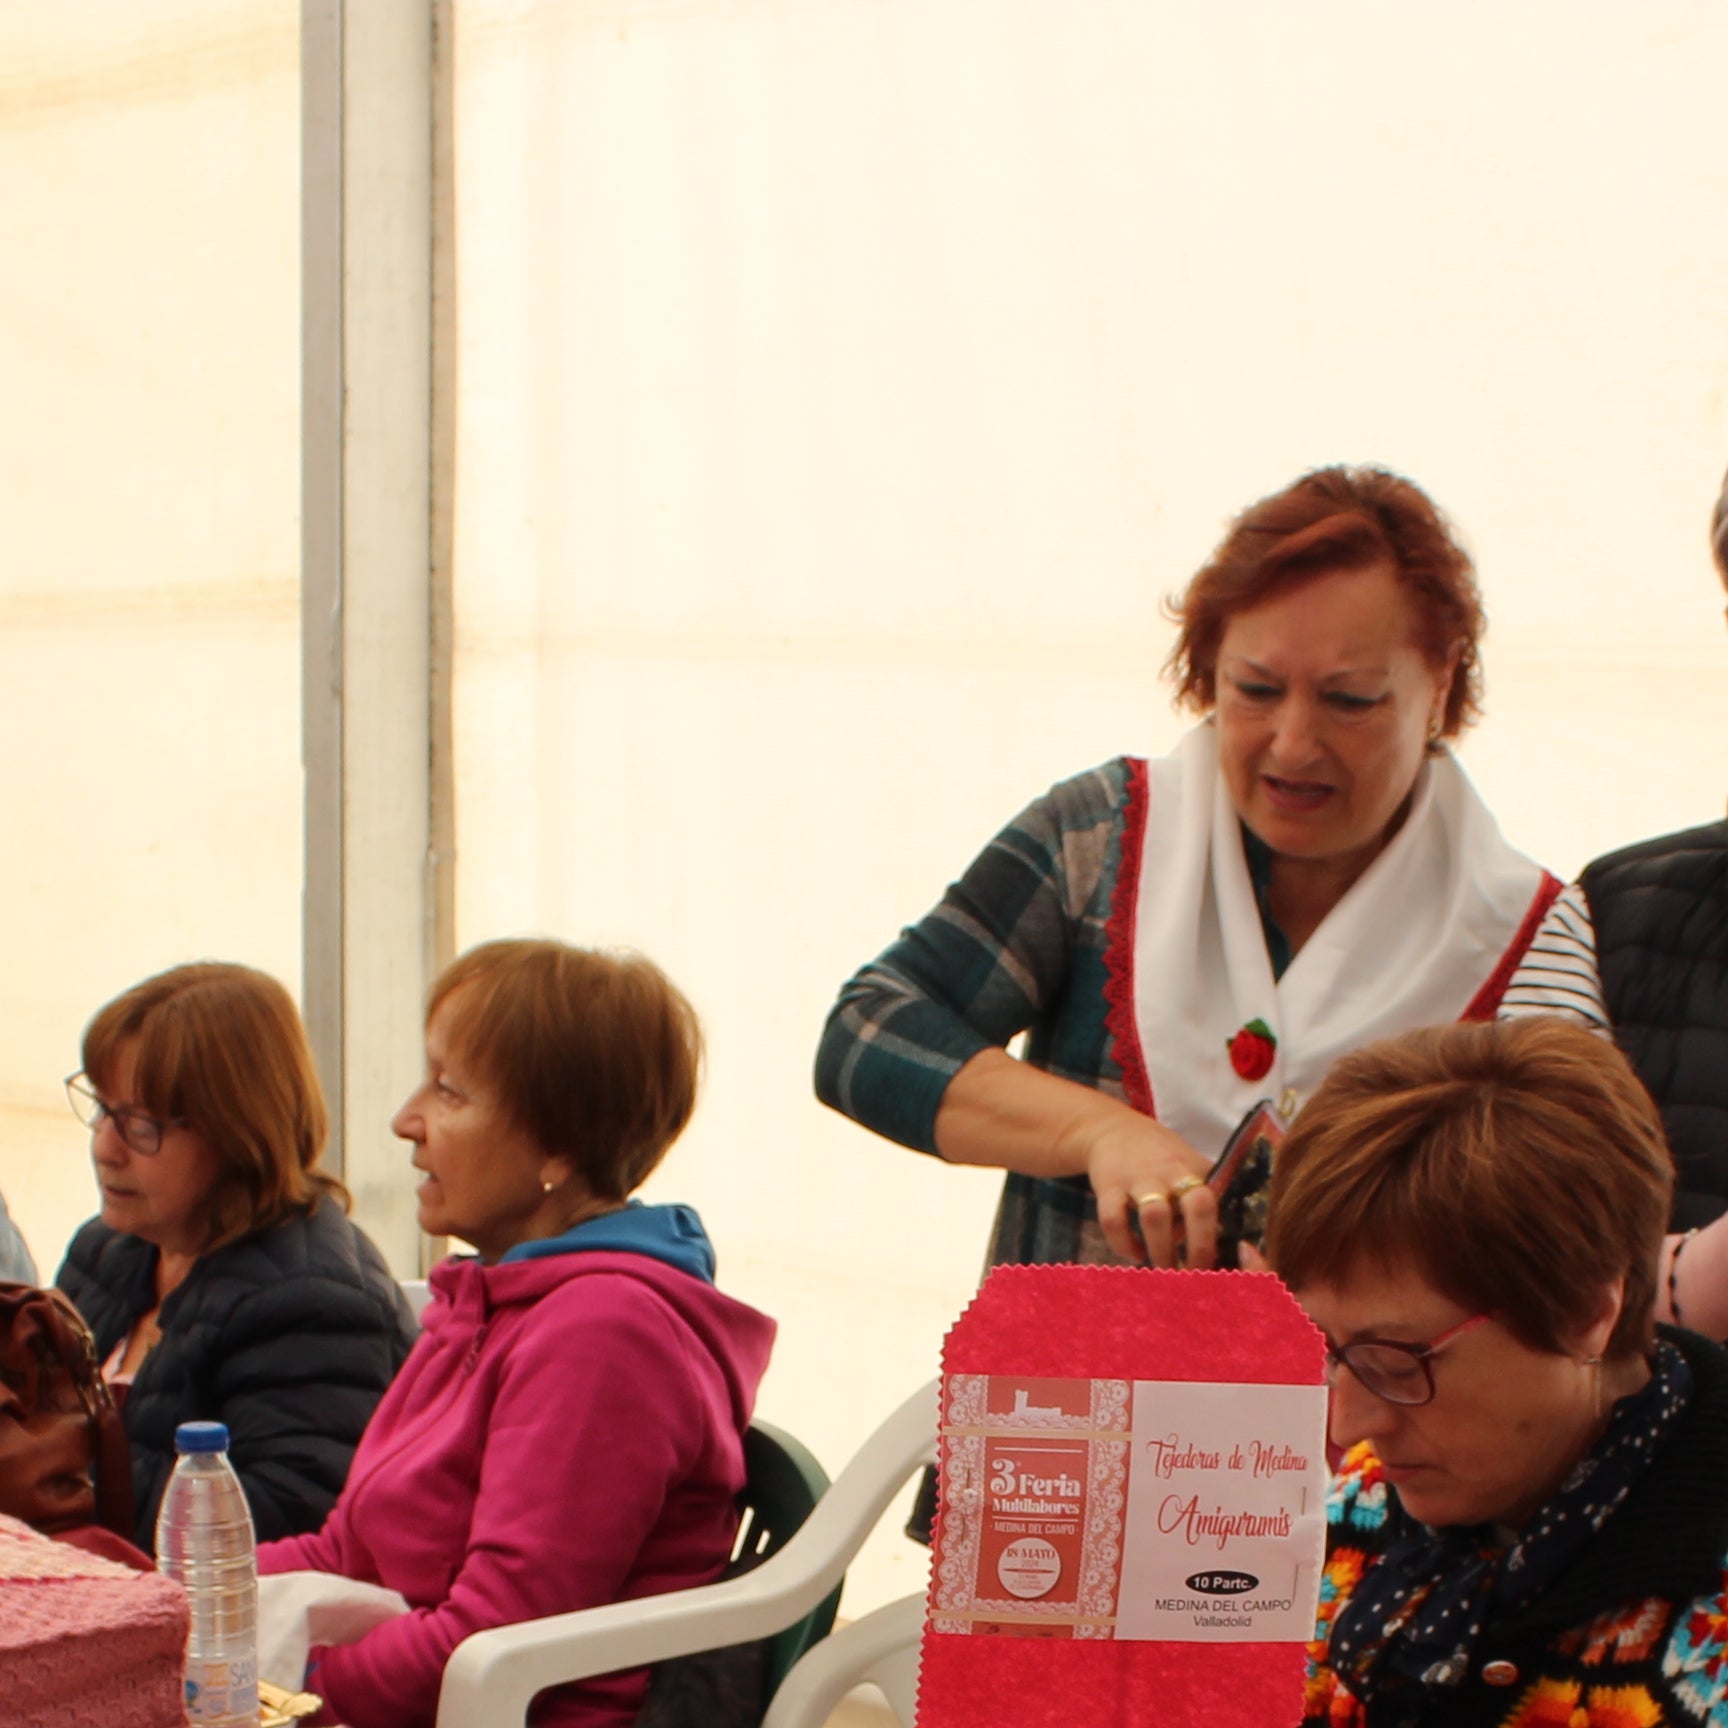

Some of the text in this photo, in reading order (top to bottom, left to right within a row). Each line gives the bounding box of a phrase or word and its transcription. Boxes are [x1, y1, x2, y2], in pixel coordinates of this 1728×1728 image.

[1145, 1432, 1309, 1480] Tejedoras de Medina
[1018, 1473, 1081, 1497] Feria
[992, 1497, 1080, 1515] Multilabores
[994, 1521, 1076, 1536] MEDINA DEL CAMPO
[1157, 1493, 1293, 1552] Amigurumis
[1006, 1547, 1057, 1560] 18 MAYO
[1192, 1576, 1253, 1590] 10 Partc.
[1154, 1599, 1292, 1612] MEDINA DEL CAMPO
[1192, 1614, 1253, 1628] Valladolid
